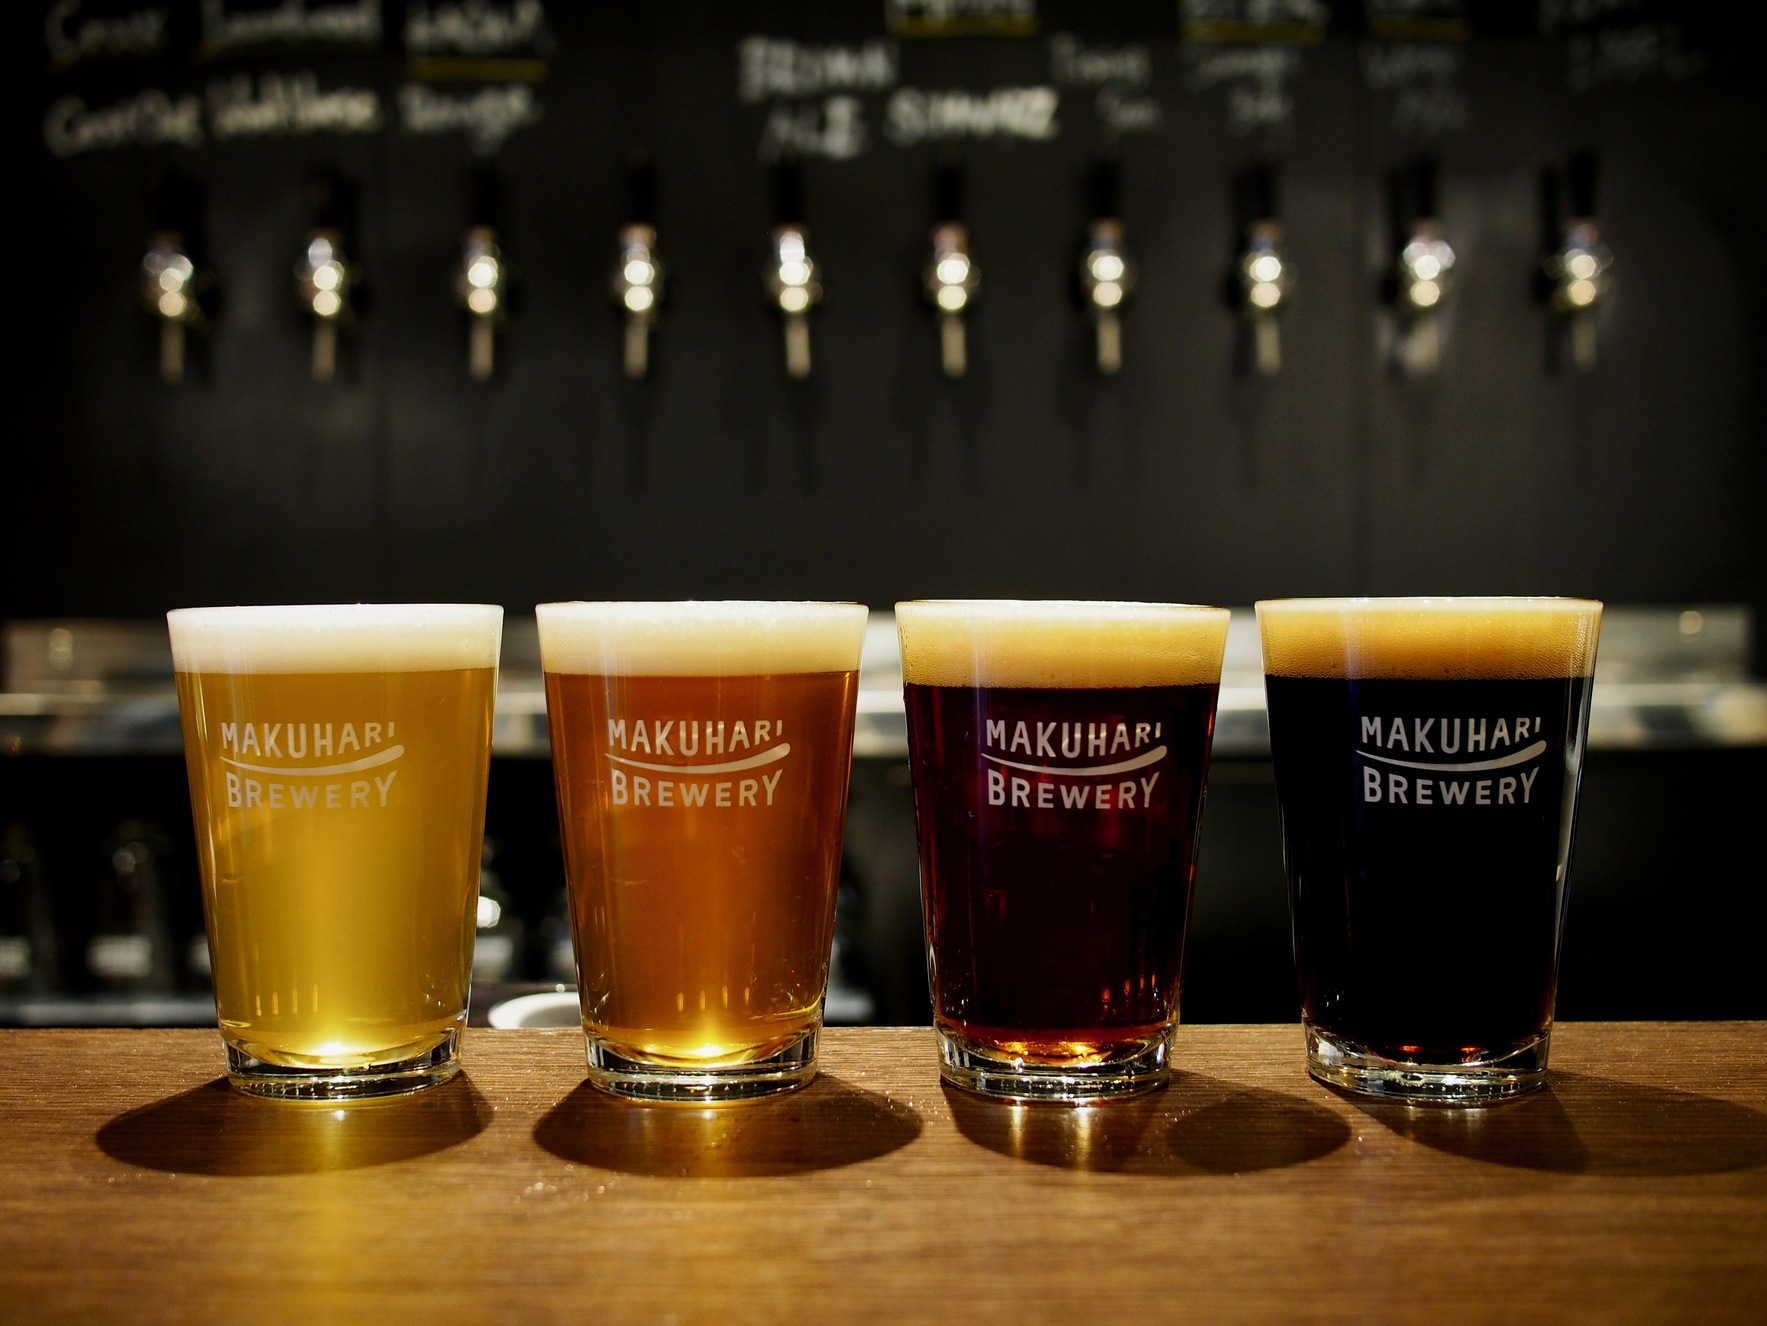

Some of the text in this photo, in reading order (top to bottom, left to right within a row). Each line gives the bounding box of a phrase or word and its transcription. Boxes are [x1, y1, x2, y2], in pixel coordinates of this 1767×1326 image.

[220, 721, 396, 760] MAKUHARI
[608, 718, 784, 757] MAKUHARI
[985, 718, 1162, 758] MAKUHARI
[1361, 715, 1542, 754] MAKUHARI
[225, 769, 398, 809] BREWERY
[610, 768, 784, 808] BREWERY
[987, 766, 1161, 810] BREWERY
[1362, 765, 1540, 806] BREWERY
